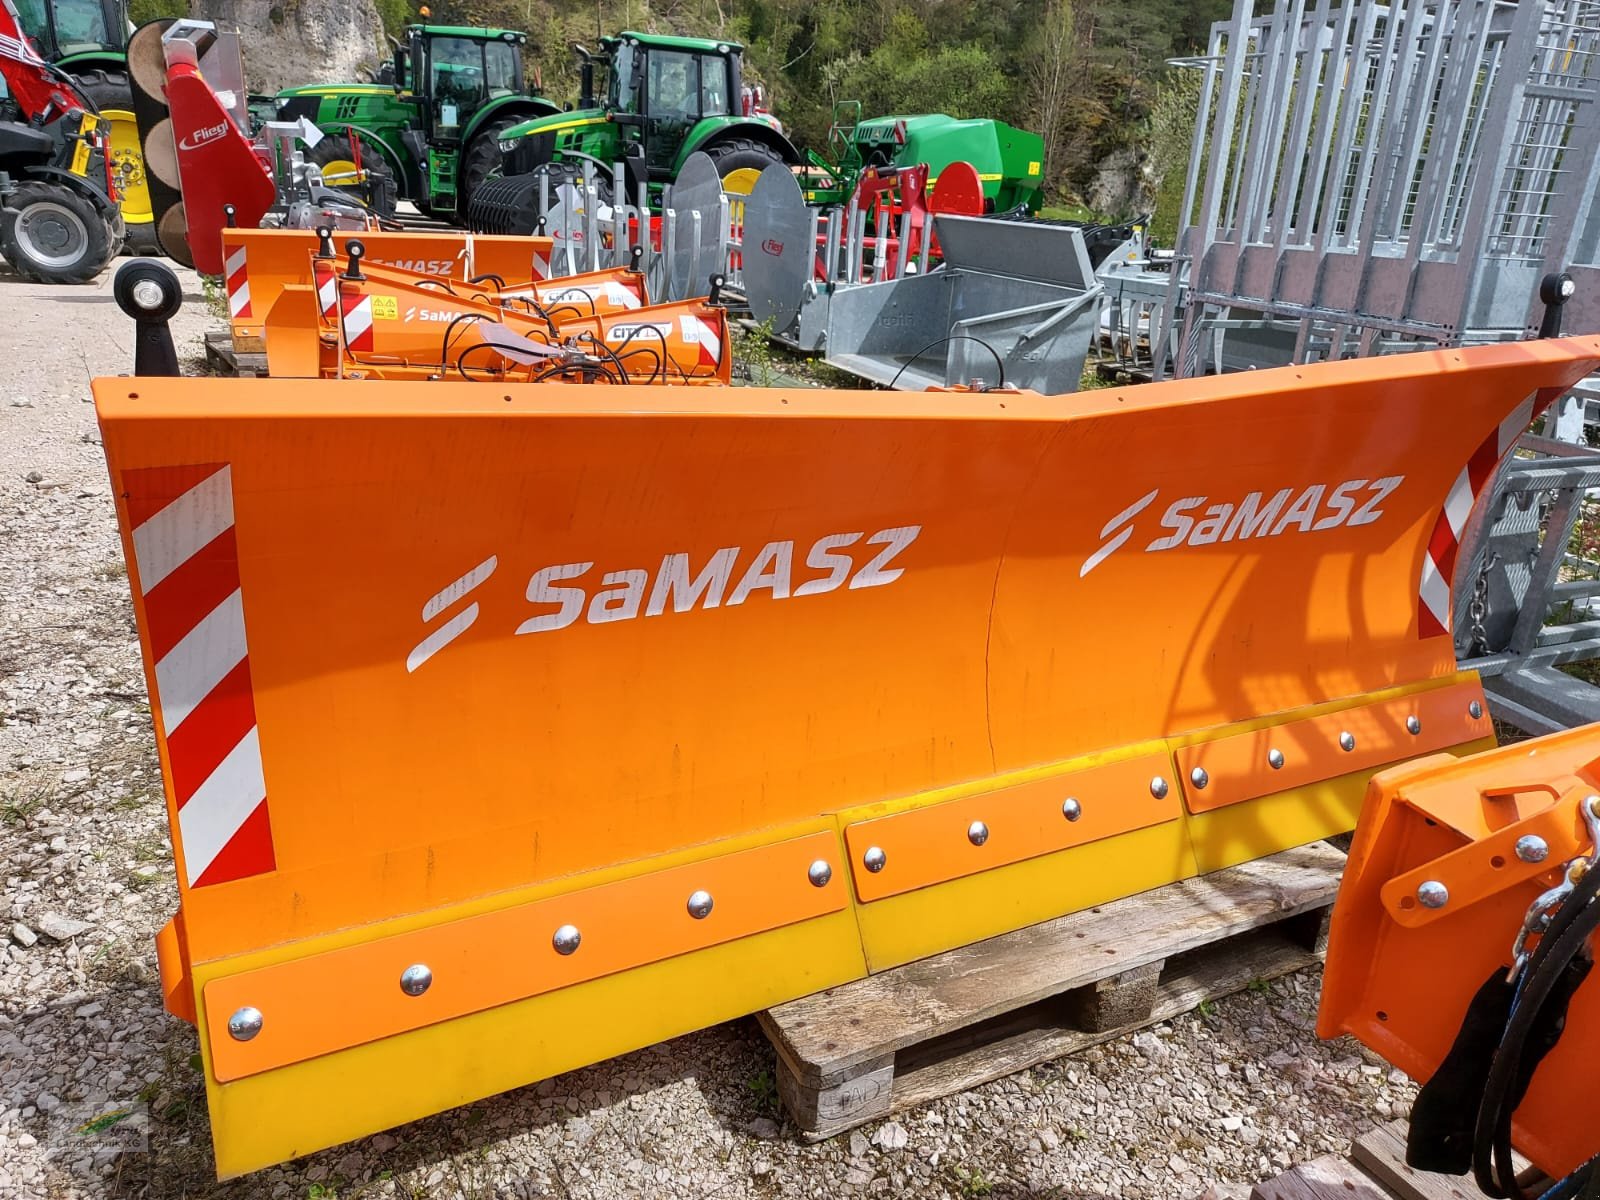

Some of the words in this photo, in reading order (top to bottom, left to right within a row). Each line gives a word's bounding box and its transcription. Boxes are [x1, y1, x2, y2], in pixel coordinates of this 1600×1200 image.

[193, 119, 228, 143] Fliegl
[1145, 475, 1405, 553] SaMASZ
[514, 525, 922, 635] SaMASZ
